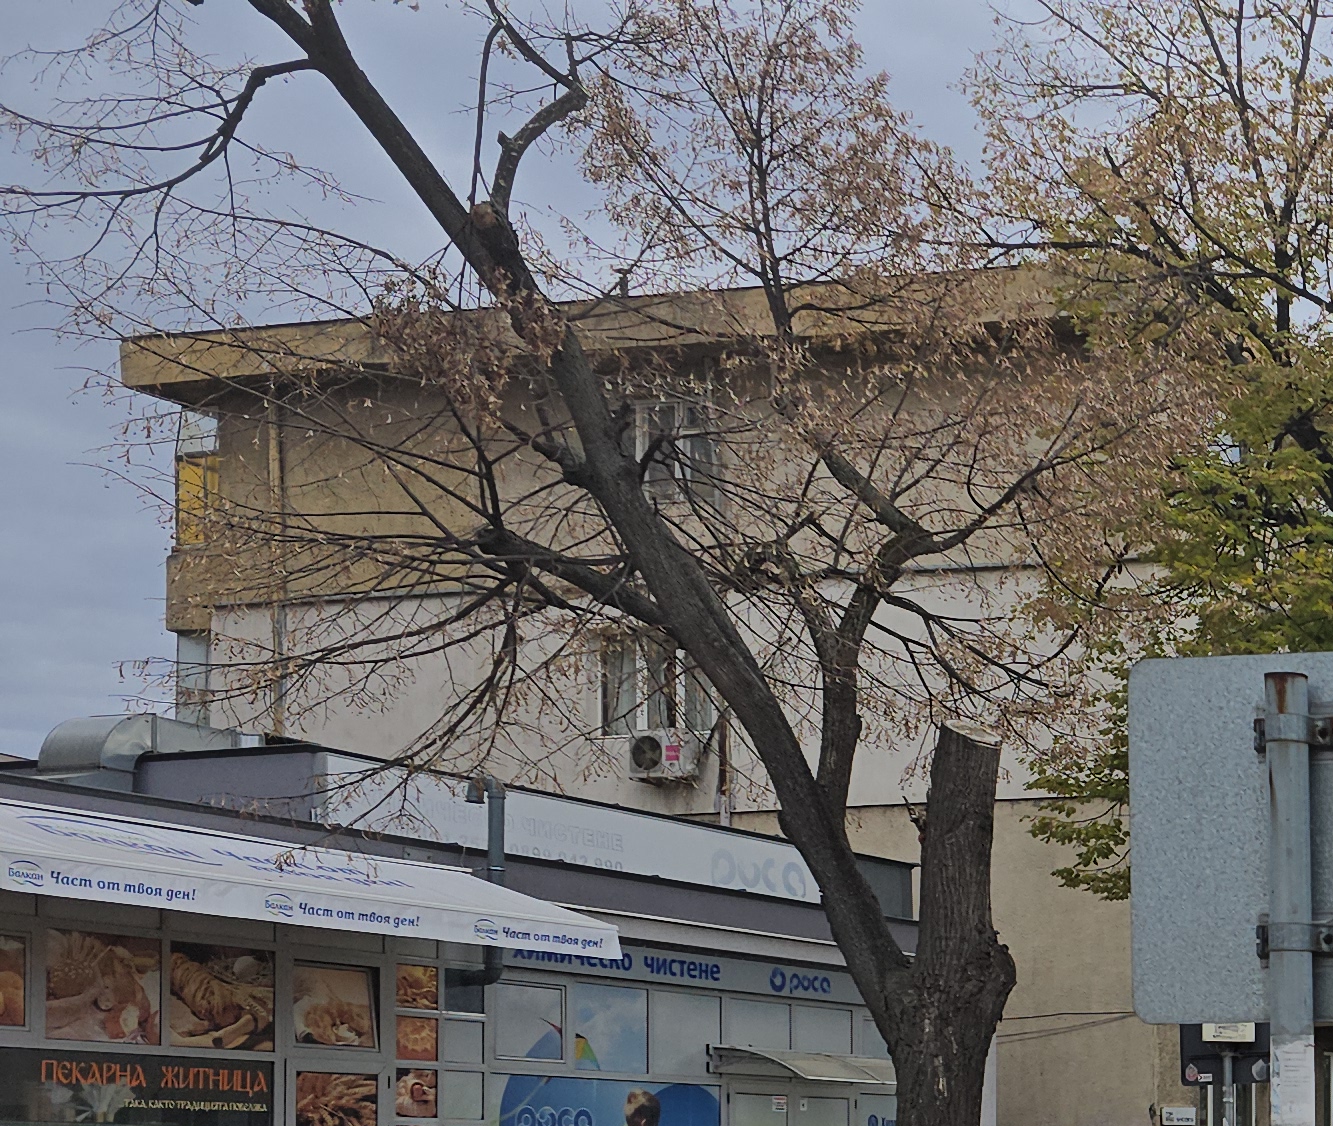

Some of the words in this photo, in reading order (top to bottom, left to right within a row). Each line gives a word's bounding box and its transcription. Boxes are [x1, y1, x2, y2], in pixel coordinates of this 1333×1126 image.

[521, 817, 624, 853] ЧИСТЕНЕ
[8, 867, 44, 881] Балкан
[50, 870, 93, 887] Част
[97, 881, 120, 892] от
[124, 882, 163, 897] твоя
[166, 888, 196, 901] ден!
[264, 899, 293, 912] Балкан
[299, 902, 333, 918] Част
[336, 909, 356, 920] от
[358, 912, 390, 924] твоя
[393, 916, 421, 928] ден!
[502, 926, 531, 941] Част
[533, 933, 550, 942] от
[552, 934, 579, 946] твоя
[581, 938, 604, 949] ден!
[643, 955, 721, 981] чистене
[788, 971, 832, 995] роса
[41, 1059, 147, 1088] ПЕКАРНА
[160, 1065, 268, 1097] ЖИТНИЦА
[149, 1099, 174, 1110] КАКТО
